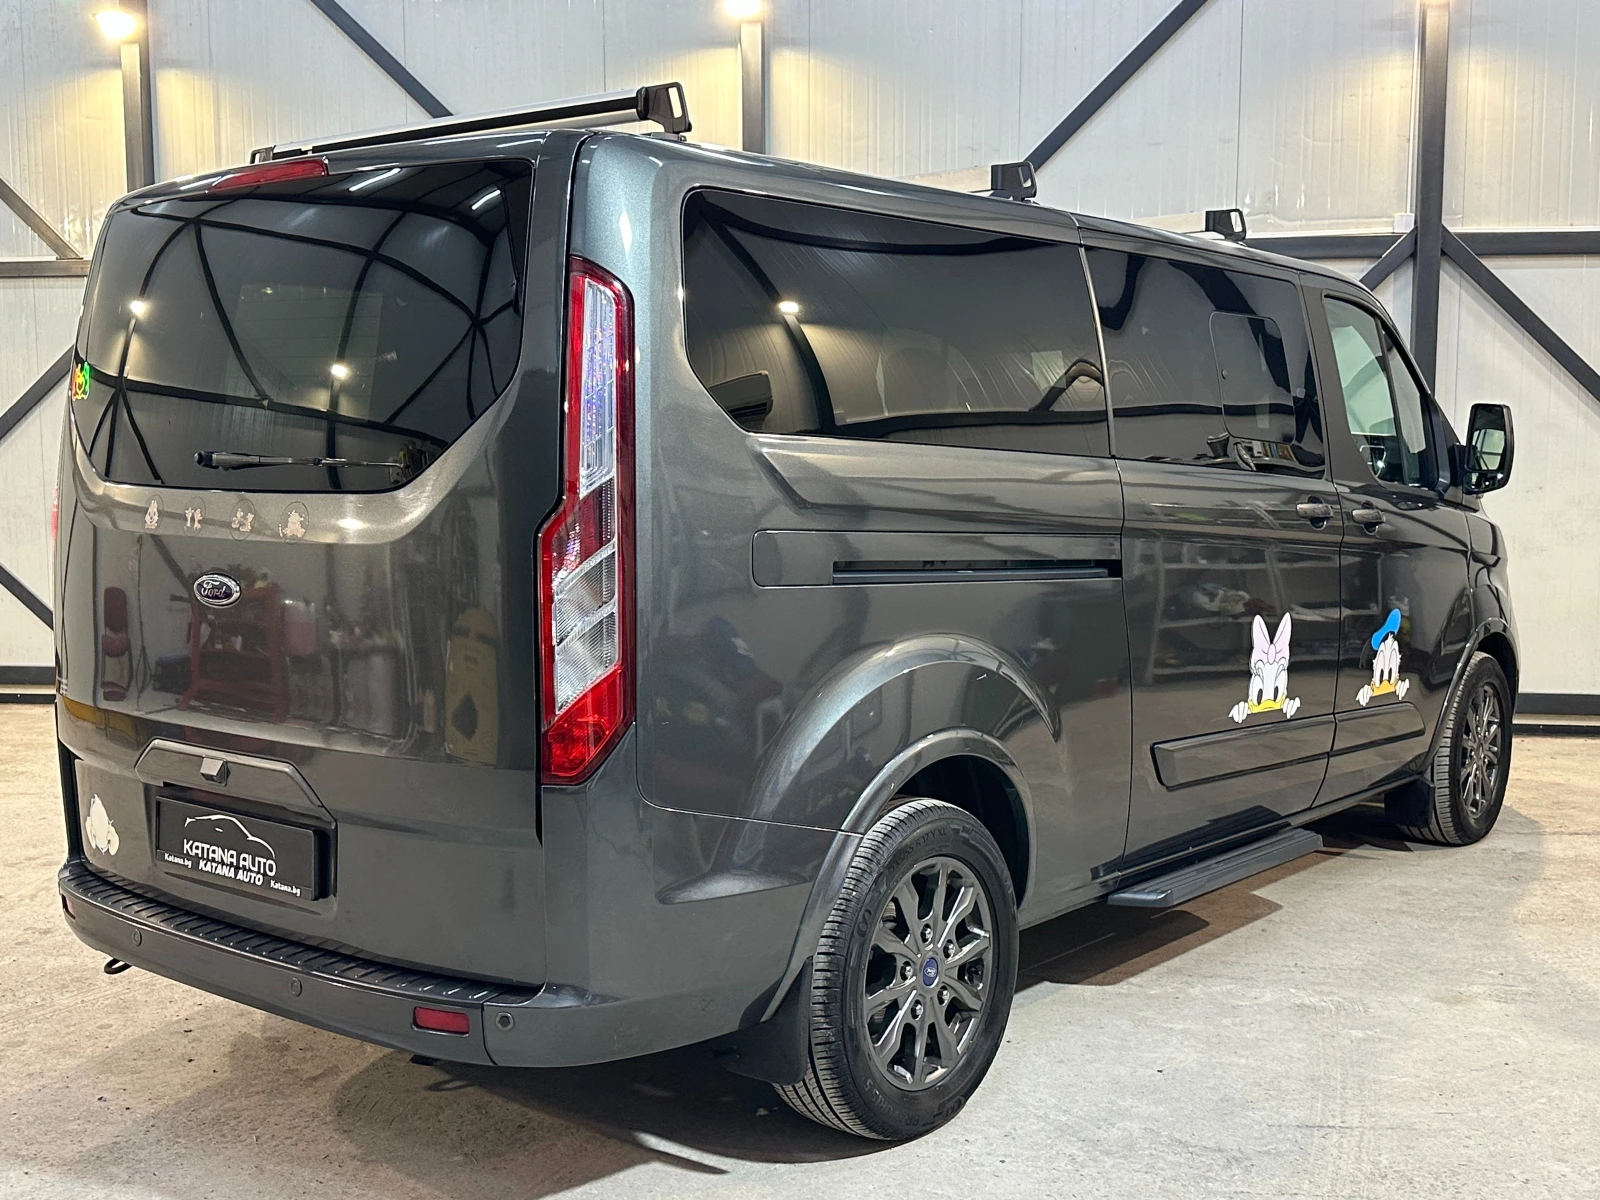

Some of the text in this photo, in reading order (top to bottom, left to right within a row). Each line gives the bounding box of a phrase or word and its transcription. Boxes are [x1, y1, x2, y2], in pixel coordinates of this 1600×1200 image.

[201, 580, 226, 598] Ford
[164, 853, 301, 897] Katana.bg KATANA AUTO Katana.bg
[183, 839, 277, 876] KATANA AUTO
